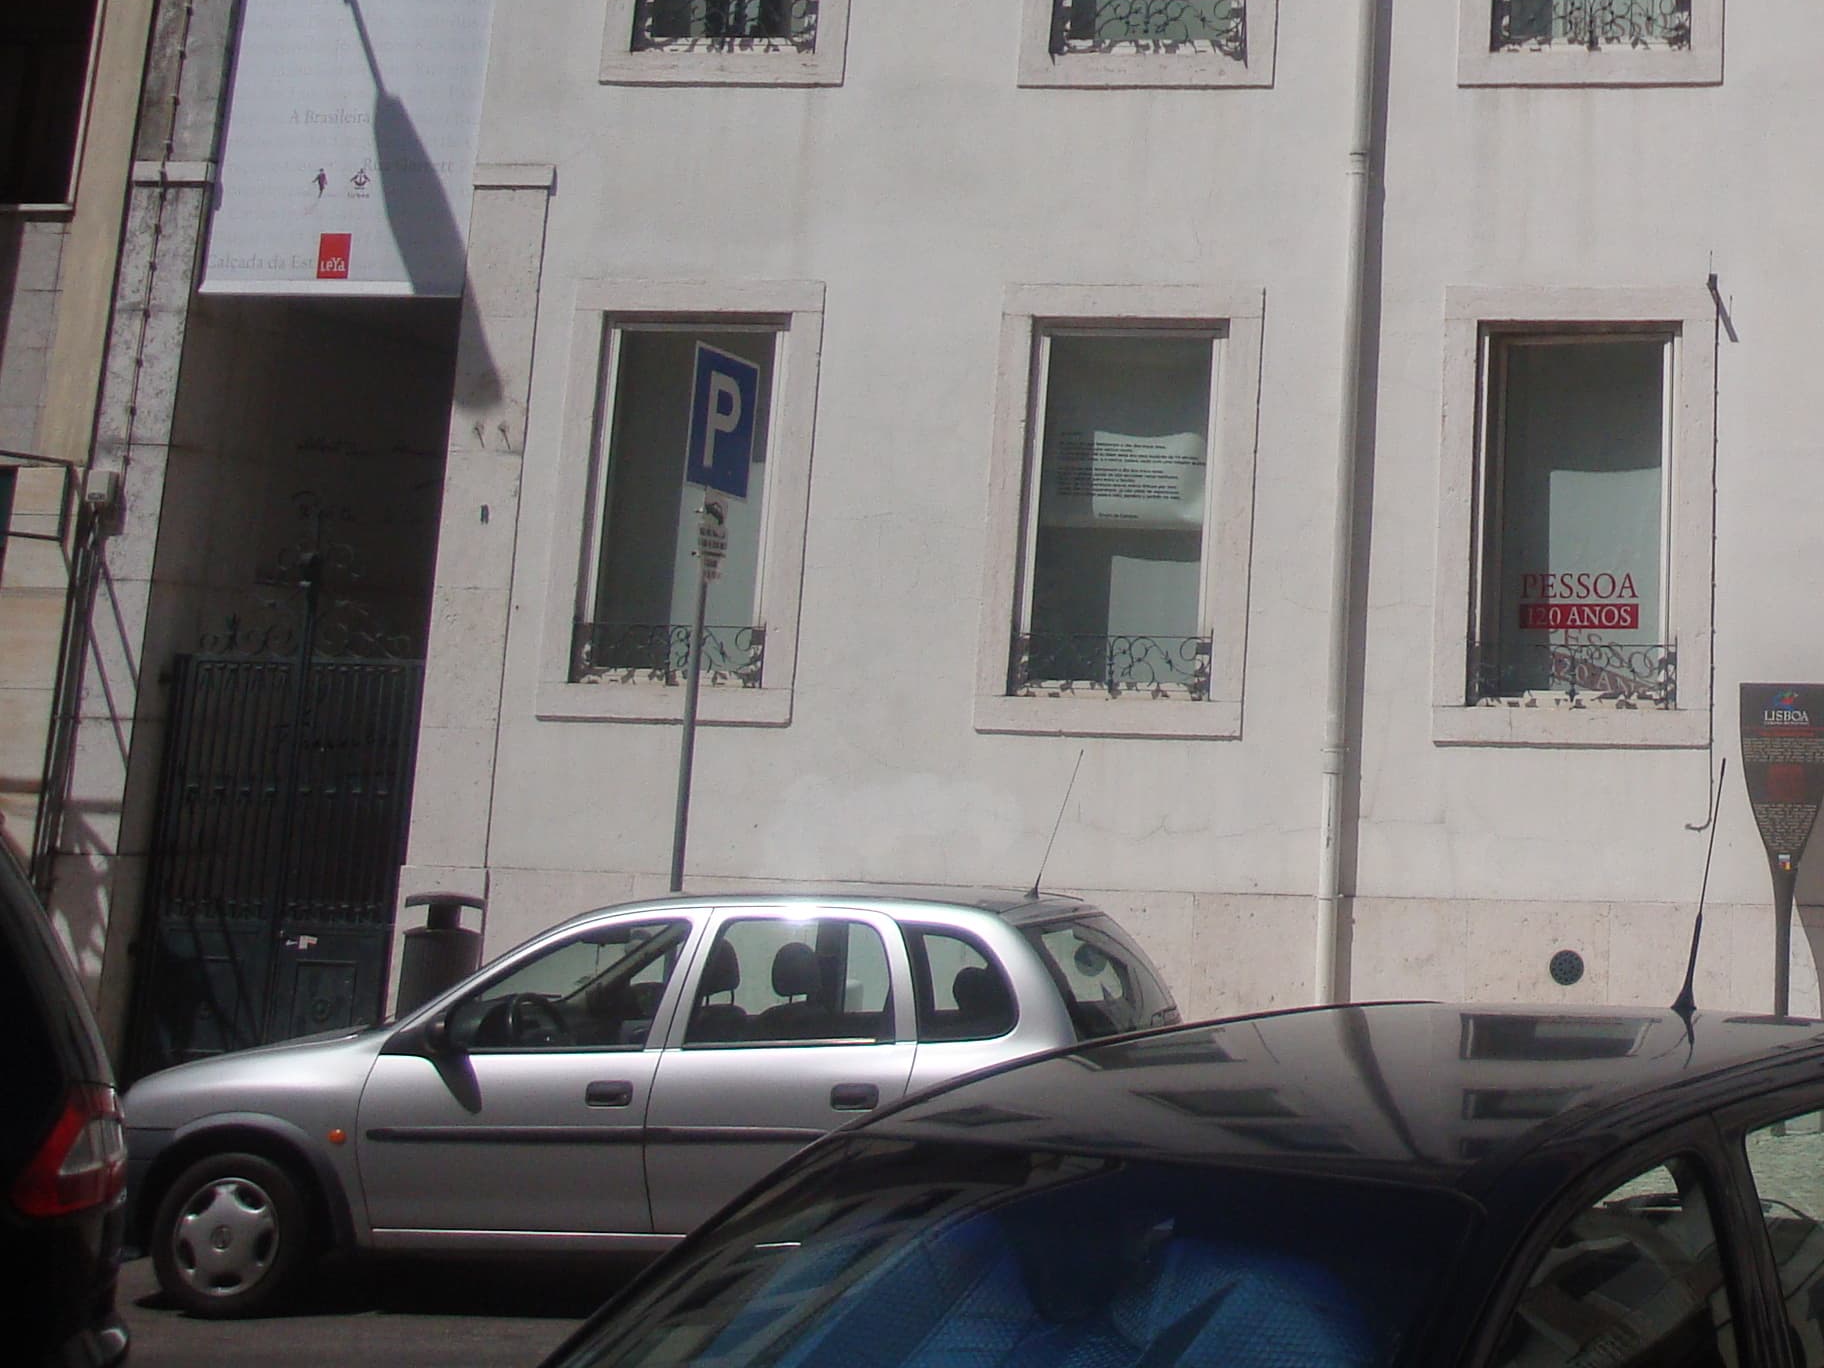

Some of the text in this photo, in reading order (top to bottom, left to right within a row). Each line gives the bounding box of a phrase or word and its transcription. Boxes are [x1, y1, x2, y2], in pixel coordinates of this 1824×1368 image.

[304, 107, 371, 125] Brasileira
[267, 252, 286, 270] da
[703, 370, 742, 468] P
[1520, 572, 1639, 600] PESSOA
[1527, 606, 1633, 626] 120 ANOS
[1763, 709, 1809, 722] LISBOA
